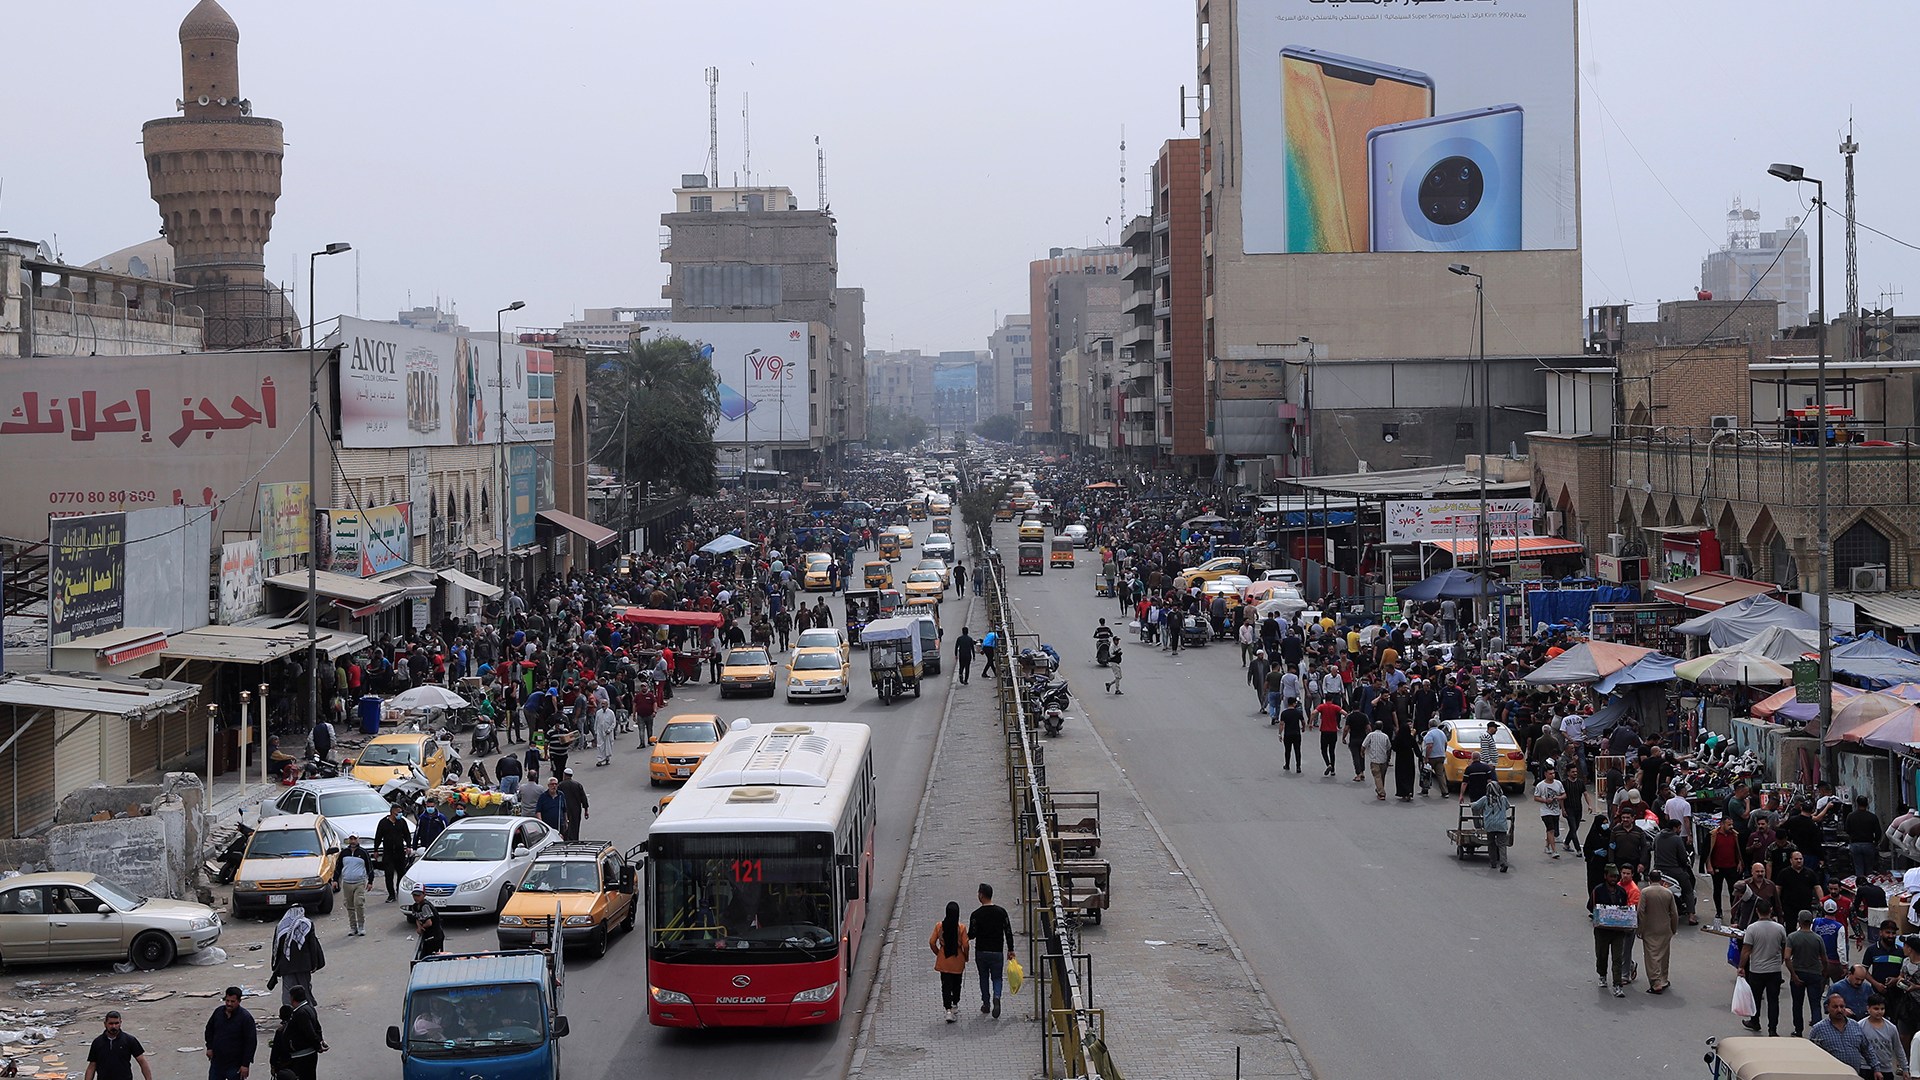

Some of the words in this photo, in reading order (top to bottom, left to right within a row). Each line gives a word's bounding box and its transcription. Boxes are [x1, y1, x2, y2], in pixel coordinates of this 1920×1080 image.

[350, 336, 397, 374] ANGY
[362, 374, 375, 382] COLOR
[0, 389, 152, 443] إعلانك
[168, 376, 276, 448] أحجز
[50, 492, 84, 504] 0770
[88, 492, 104, 502] 80
[108, 491, 126, 502] 80
[129, 490, 156, 502] 800
[64, 566, 92, 605] الشيخ
[94, 554, 115, 592] أحمد
[732, 860, 763, 883] 121
[716, 996, 739, 1004] KING
[740, 996, 766, 1004] LONG
